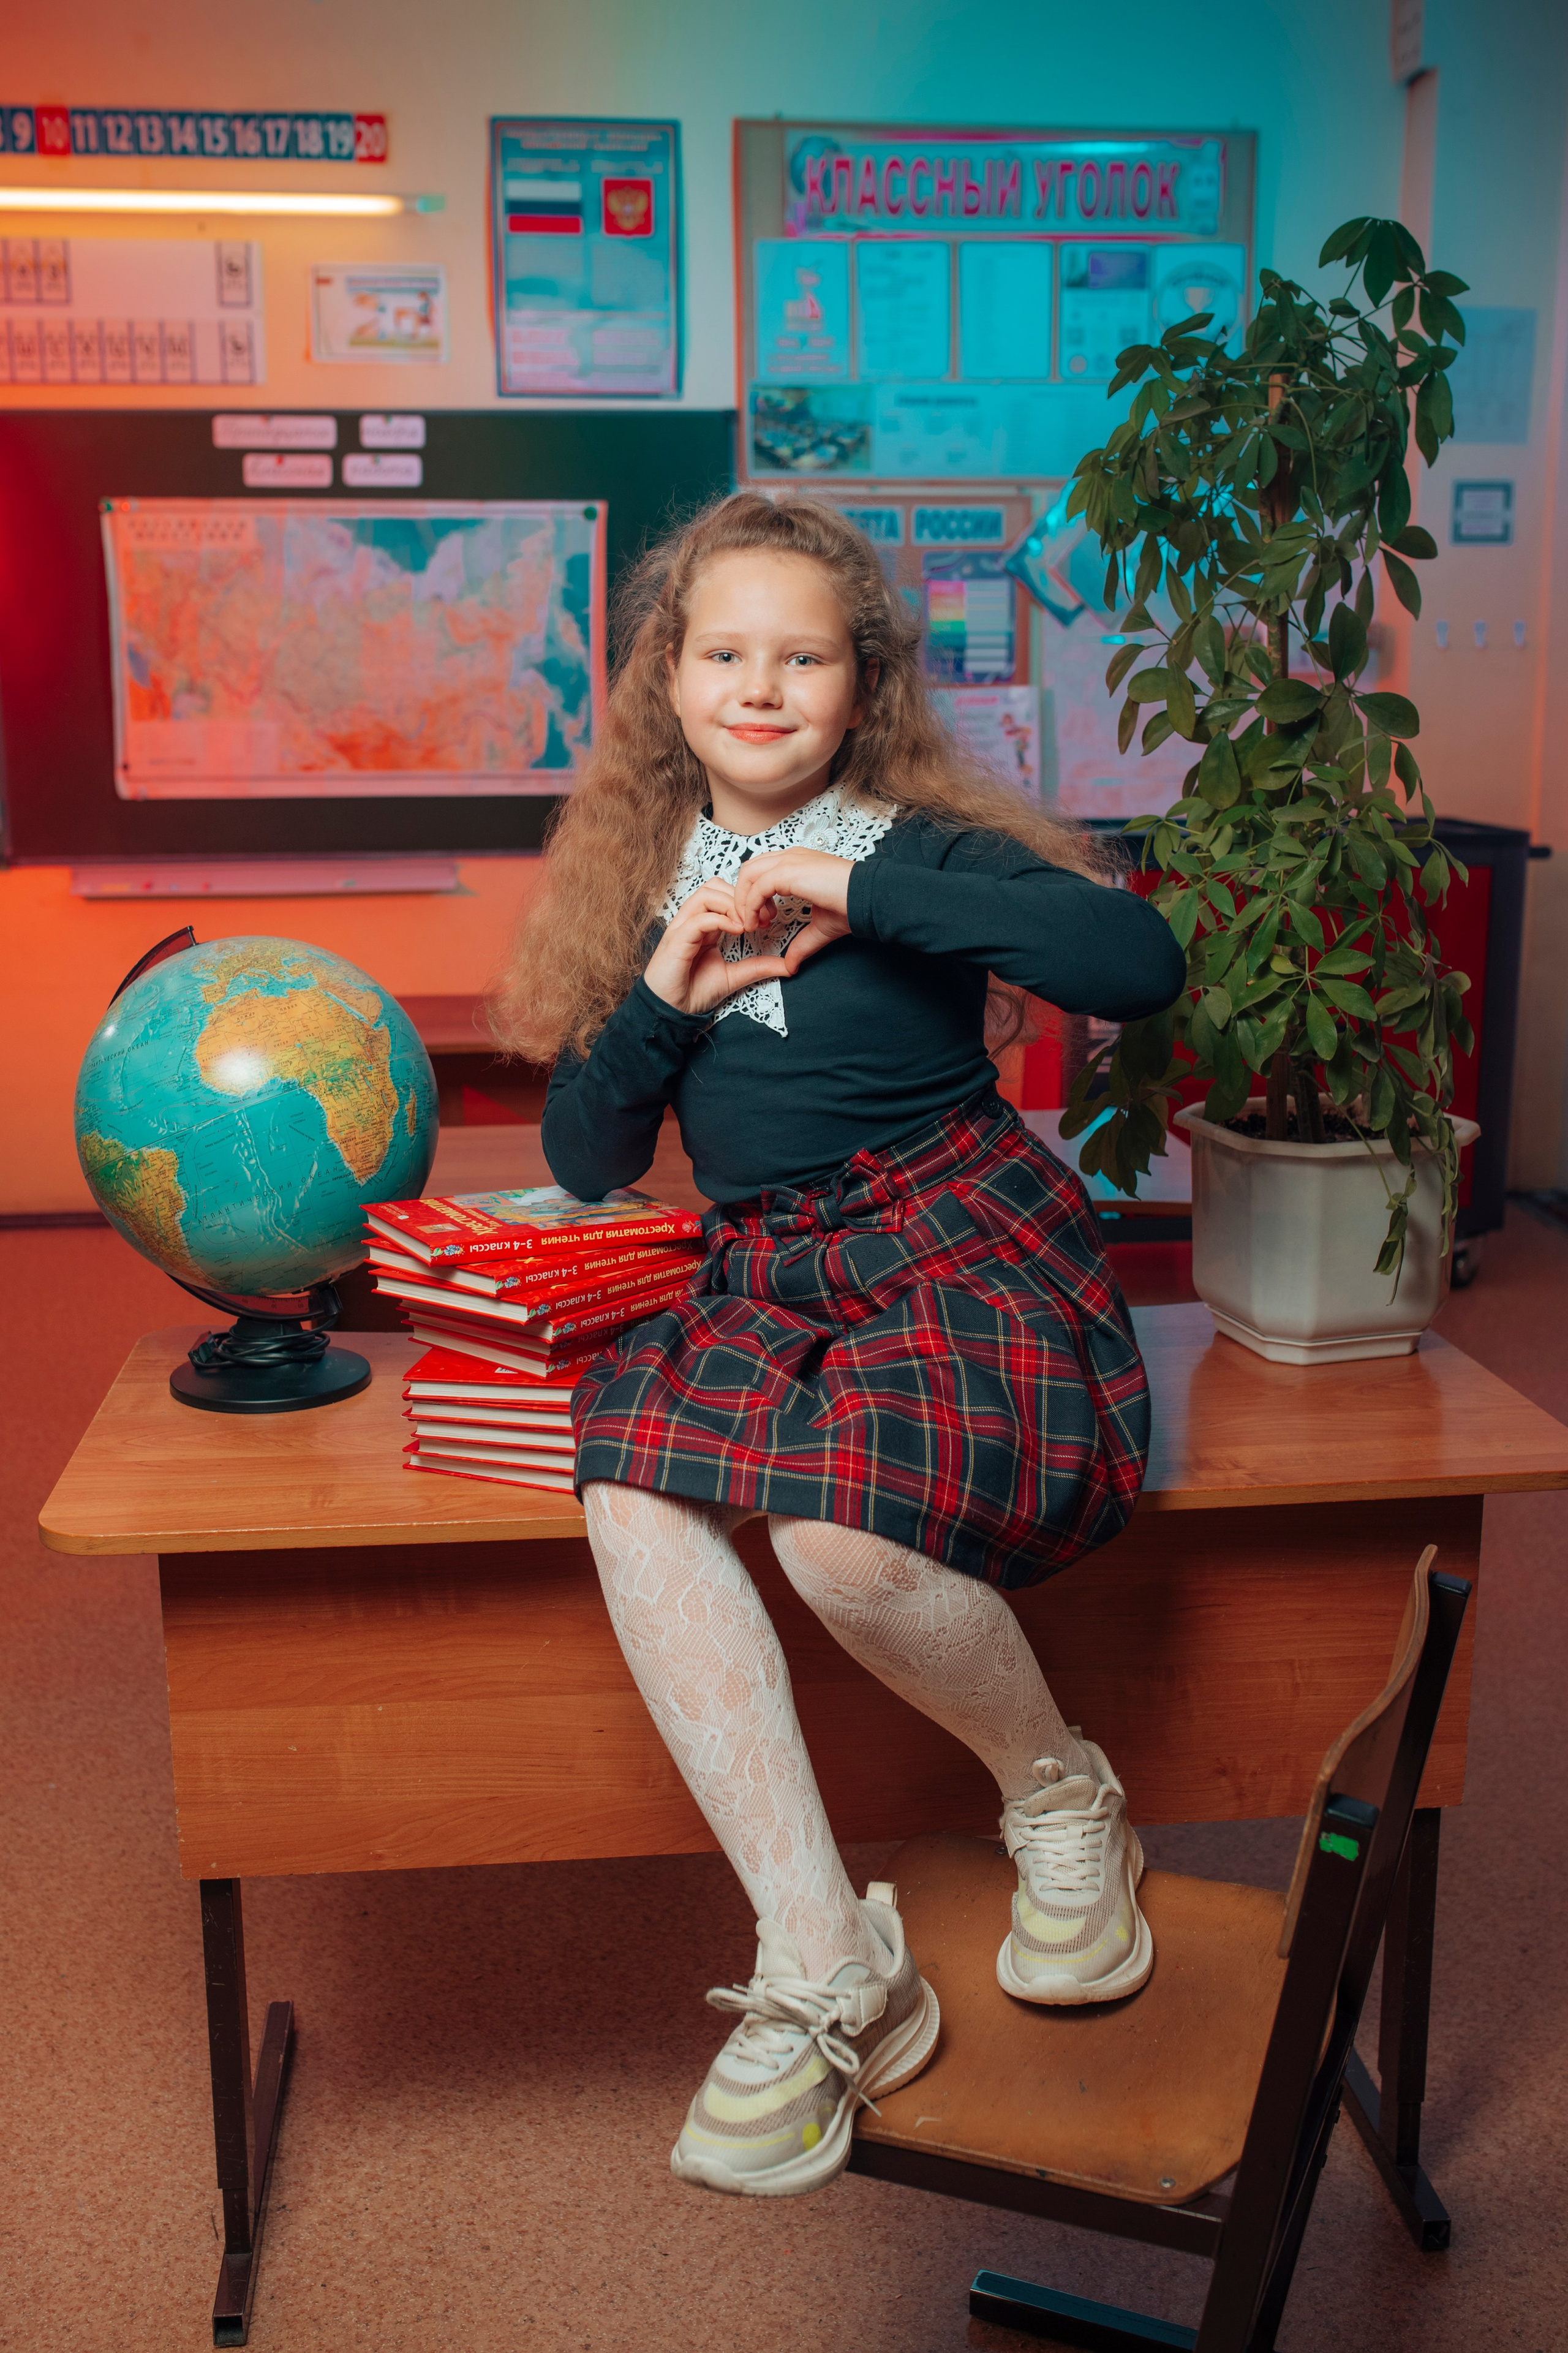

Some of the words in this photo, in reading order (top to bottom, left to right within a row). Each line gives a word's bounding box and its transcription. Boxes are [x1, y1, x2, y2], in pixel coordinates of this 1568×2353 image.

[12, 111, 31, 150] 9
[42, 116, 69, 150] 10
[72, 114, 97, 151] 11
[102, 115, 134, 151] 12
[134, 115, 164, 151] 13
[167, 116, 197, 153] 14
[200, 118, 228, 153] 15
[231, 118, 261, 154] 16
[263, 118, 290, 154] 17
[292, 119, 323, 154] 18
[326, 120, 353, 156] 19
[354, 121, 385, 157] 20
[804, 151, 1021, 219] КЛАССНЫЙ
[1033, 159, 1180, 221] УГОЛОК
[916, 508, 1003, 540] РОССИИ
[127, 1040, 149, 1053] ОКЕАН
[198, 1181, 293, 1225] АТЛАНТИЧЕСКИЙ
[301, 1166, 337, 1184] ОКЕАН
[583, 1229, 604, 1242] для
[606, 1223, 675, 1239] Хрестоматия
[513, 1239, 533, 1250] 3-4
[541, 1233, 579, 1245] чтения
[469, 1241, 510, 1253] классы
[637, 1239, 693, 1258] Хрестоматия
[619, 1252, 635, 1263] для
[584, 1258, 616, 1271] чтения
[653, 1260, 702, 1280] Хрестоматия
[526, 1270, 559, 1283] классы
[562, 1265, 578, 1278] 3-4
[637, 1274, 651, 1286] для
[607, 1281, 636, 1295] чтения
[556, 1295, 586, 1310] классы
[587, 1290, 601, 1302] 3-4
[659, 1293, 674, 1303] для
[630, 1299, 658, 1312] чтения
[611, 1307, 625, 1318] 3-4
[581, 1312, 609, 1328] классы
[578, 1328, 609, 1343] классы
[576, 1351, 603, 1365] ассы
